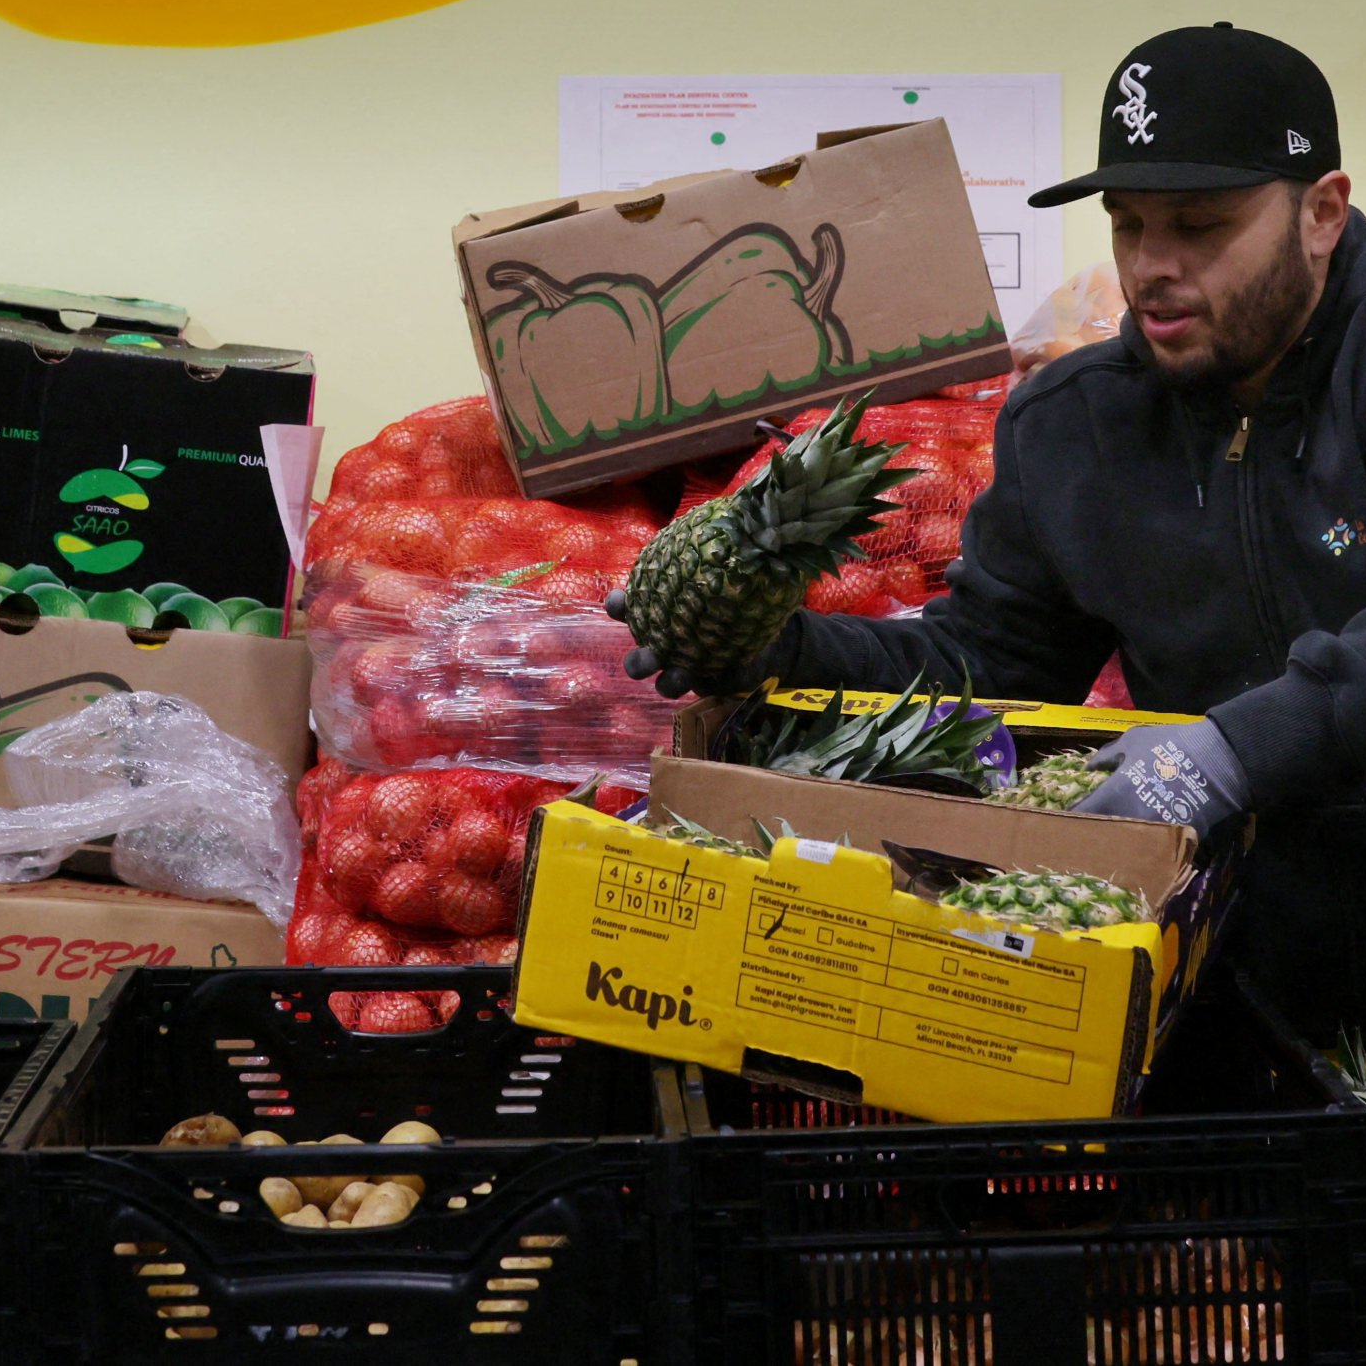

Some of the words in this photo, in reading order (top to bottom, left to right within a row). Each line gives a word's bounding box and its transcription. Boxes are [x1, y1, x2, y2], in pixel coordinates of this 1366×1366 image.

[962, 177, 1026, 187] olaborativa
[1, 426, 40, 442] LIMES
[177, 447, 237, 464] PREMIUM
[85, 504, 120, 515] CITRICOS
[72, 514, 129, 536] SAAO
[586, 961, 697, 1031] Kapi
